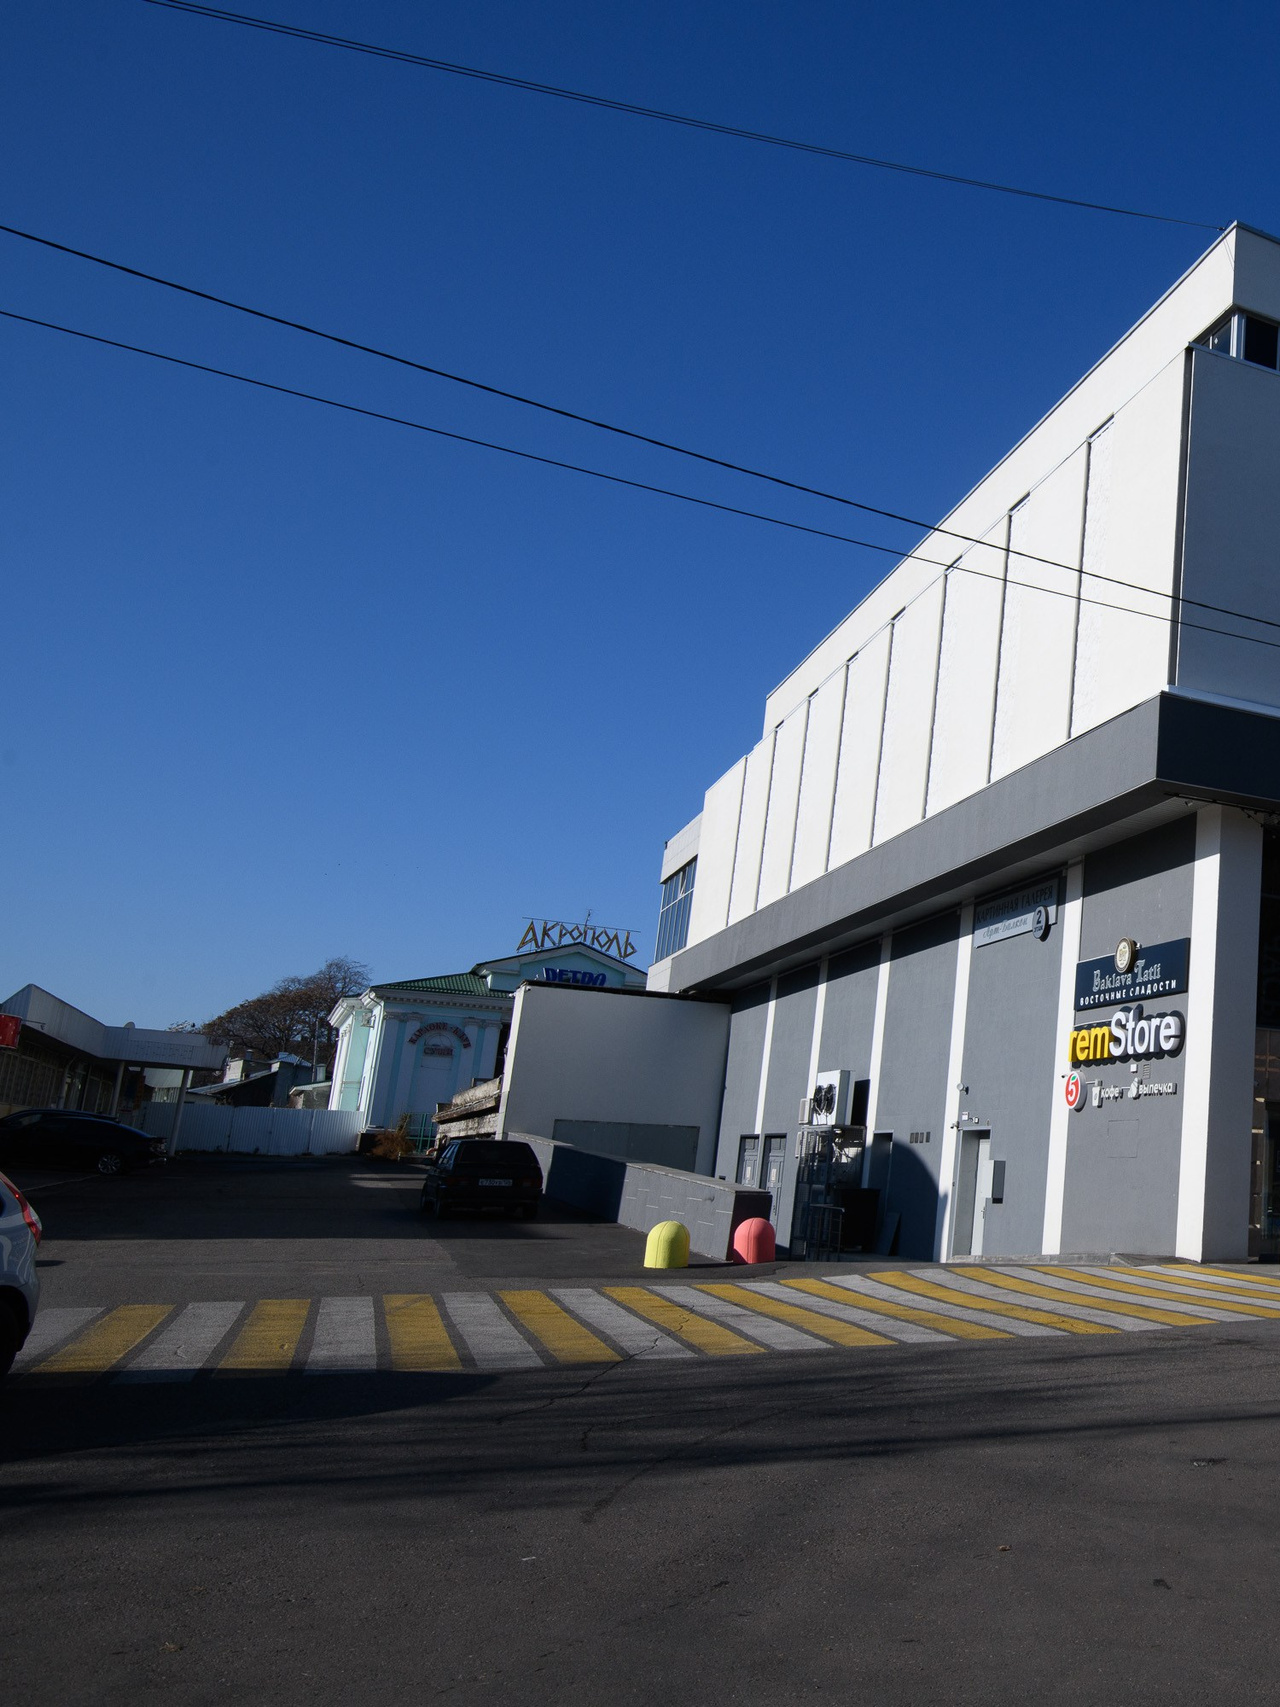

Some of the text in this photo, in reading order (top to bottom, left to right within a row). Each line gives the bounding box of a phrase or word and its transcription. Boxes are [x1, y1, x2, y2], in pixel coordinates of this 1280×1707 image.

[976, 885, 1054, 924] КАРТИННАЯ ГАЛЕРЕЯ
[1036, 910, 1043, 925] 2
[516, 920, 638, 959] АКРОПОЛЬ
[1092, 959, 1161, 992] Baklava Tatli
[1079, 979, 1177, 1006] ВОСТОЧНЫЕ СЛАДОСТИ
[1068, 1008, 1181, 1062] remStore
[1101, 1083, 1173, 1100] кофе выпечка
